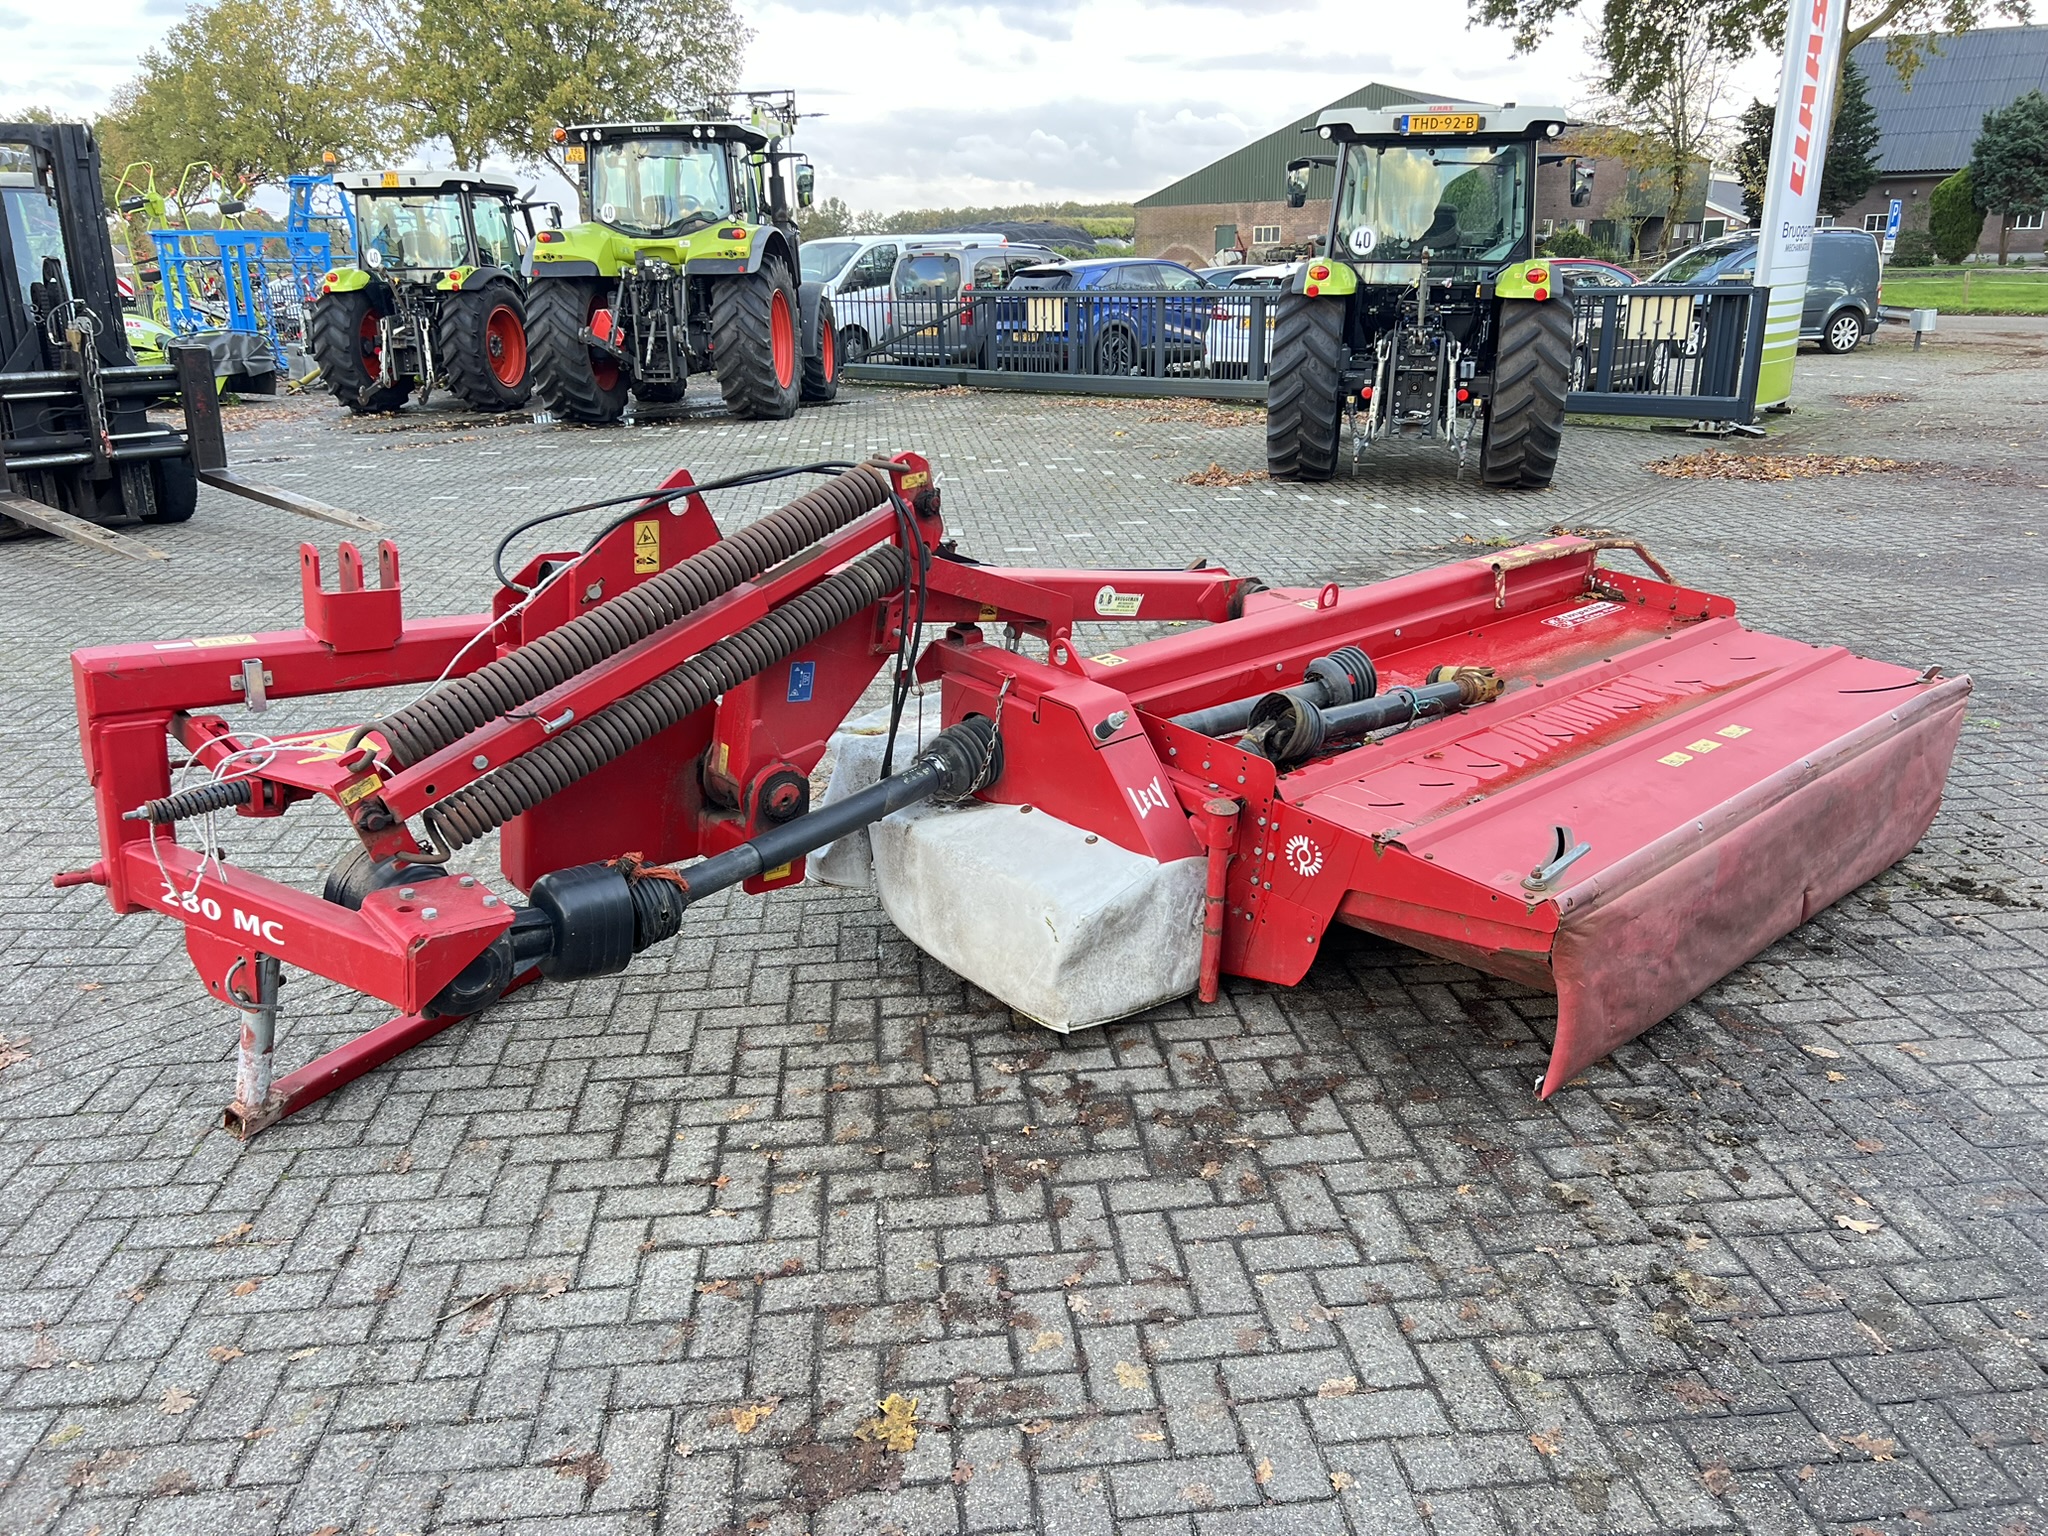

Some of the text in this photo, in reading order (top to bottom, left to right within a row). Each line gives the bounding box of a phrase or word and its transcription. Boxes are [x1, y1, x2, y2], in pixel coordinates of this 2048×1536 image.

[1412, 117, 1474, 129] THD-92-B
[603, 206, 613, 218] 40
[1355, 231, 1371, 249] 40
[369, 251, 379, 263] 40
[160, 882, 285, 945] 280 MC
